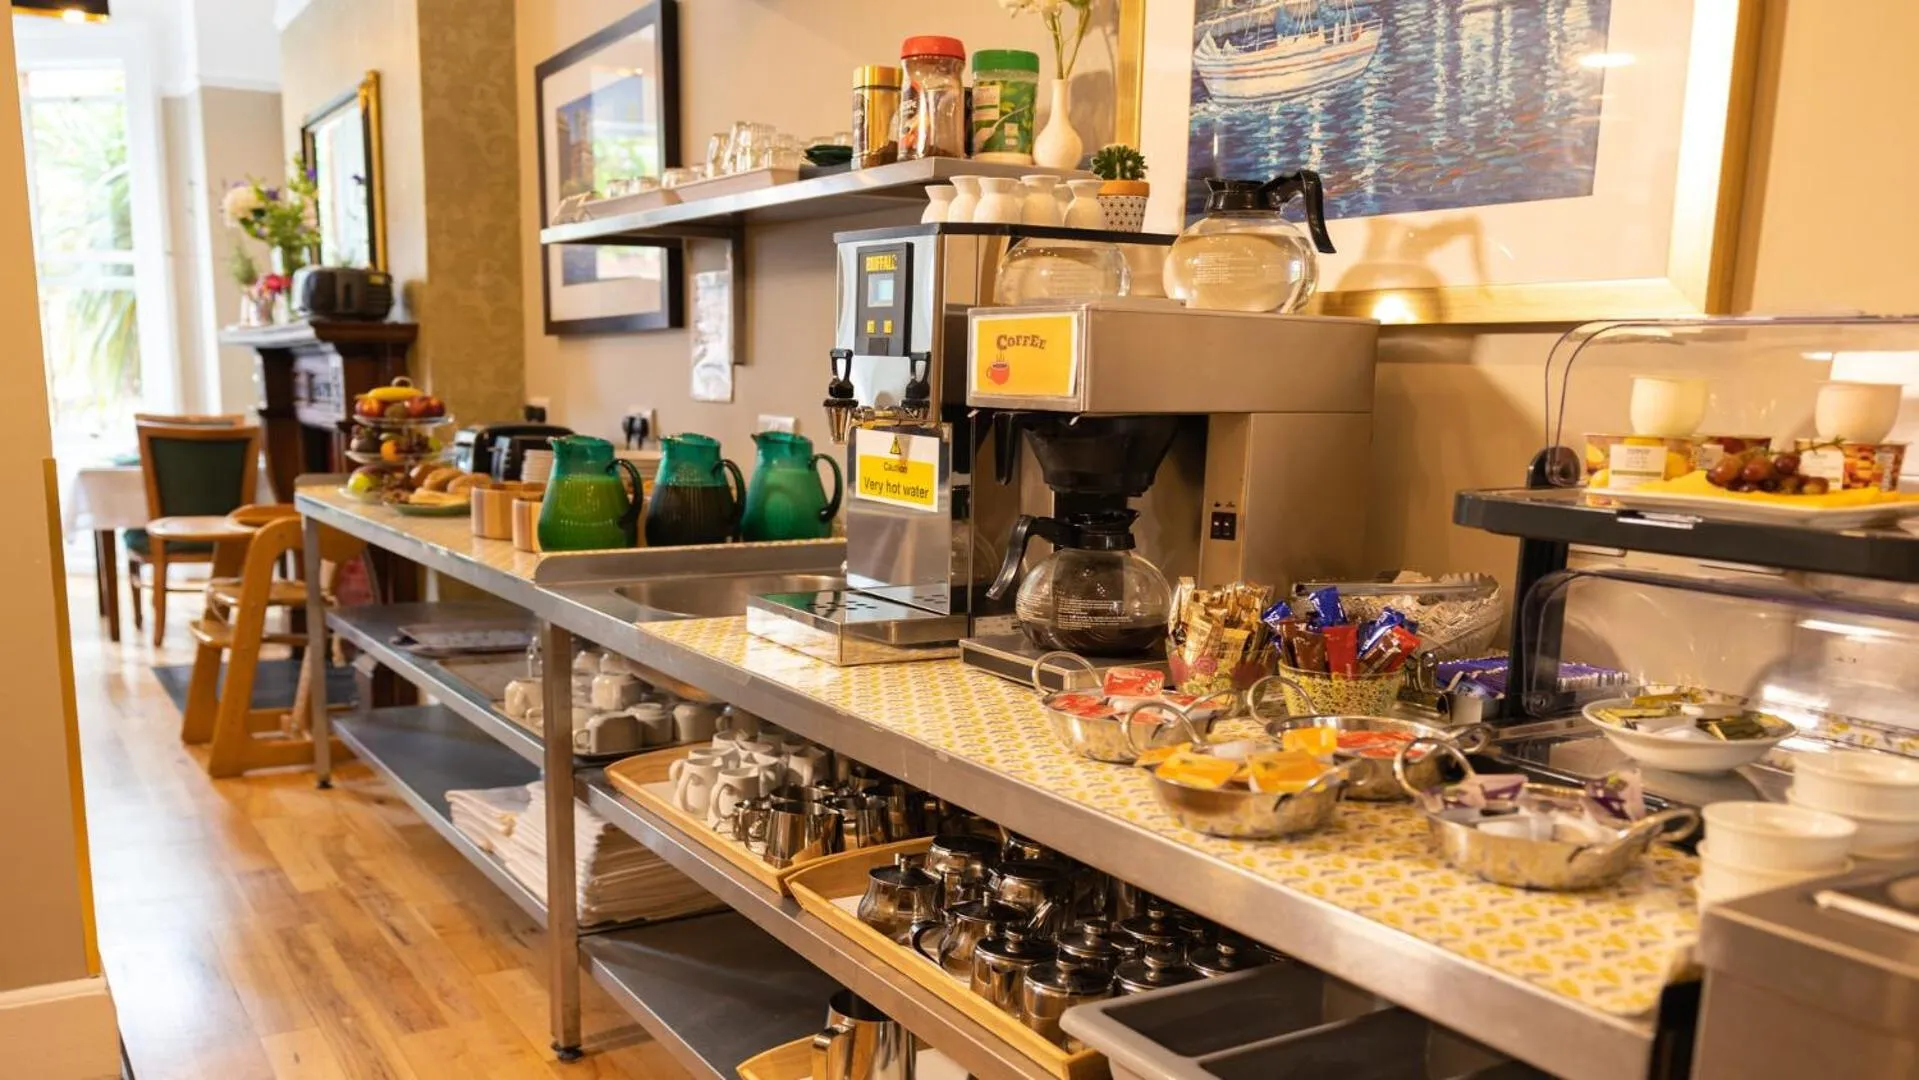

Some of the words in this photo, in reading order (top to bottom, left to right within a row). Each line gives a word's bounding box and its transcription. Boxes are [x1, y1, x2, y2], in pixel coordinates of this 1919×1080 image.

[883, 461, 908, 474] Caution
[864, 476, 884, 494] Very
[886, 479, 901, 496] hot
[903, 484, 930, 499] water
